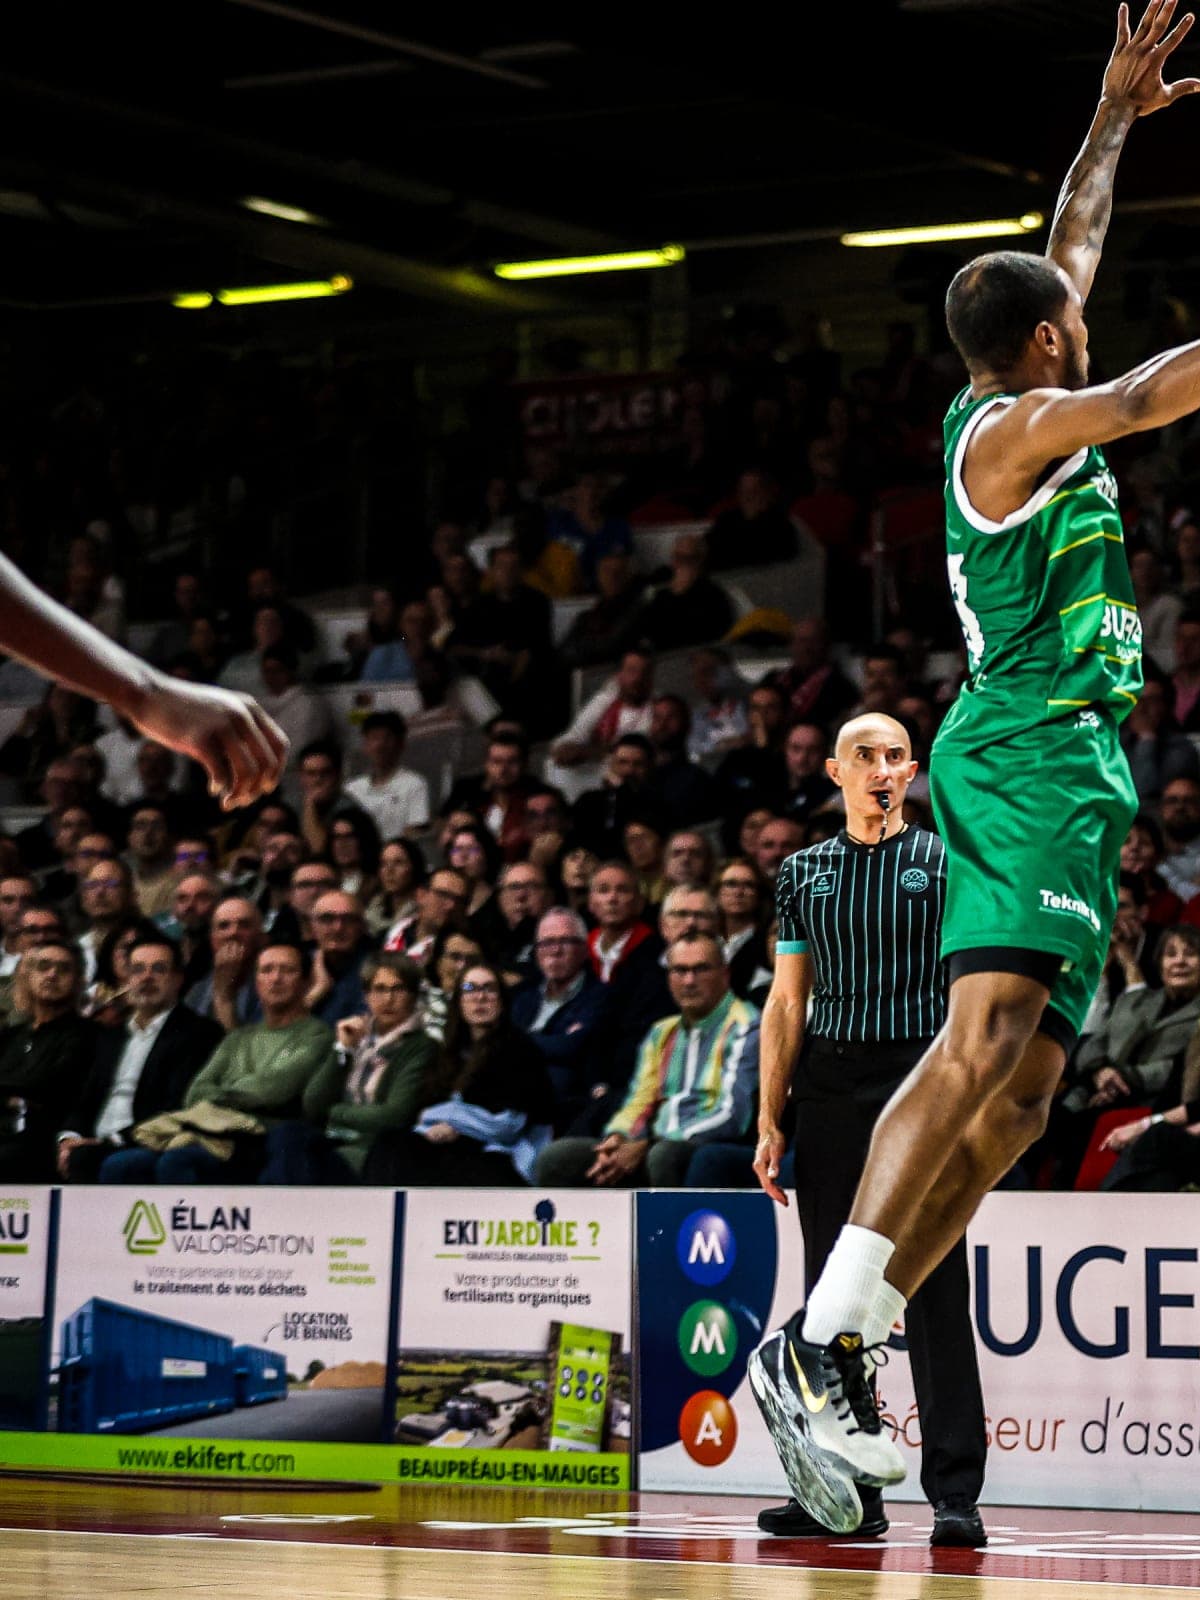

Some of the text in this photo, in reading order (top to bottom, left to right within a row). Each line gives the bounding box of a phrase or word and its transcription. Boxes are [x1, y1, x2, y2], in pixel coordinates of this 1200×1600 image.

[171, 1200, 251, 1232] ÉLAN
[171, 1233, 315, 1256] VALORISATION
[587, 1221, 601, 1247] ?
[133, 1280, 308, 1298] le traitement de vos déchets
[456, 1273, 580, 1289] Votre producteur de
[444, 1289, 592, 1309] fertilisants organiques
[284, 1312, 349, 1325] LOCATION
[303, 1327, 353, 1341] BENNES
[118, 1446, 295, 1474] www.ekifert.com
[399, 1454, 621, 1486] BEAUPRÉAU-EN-MAUGES
